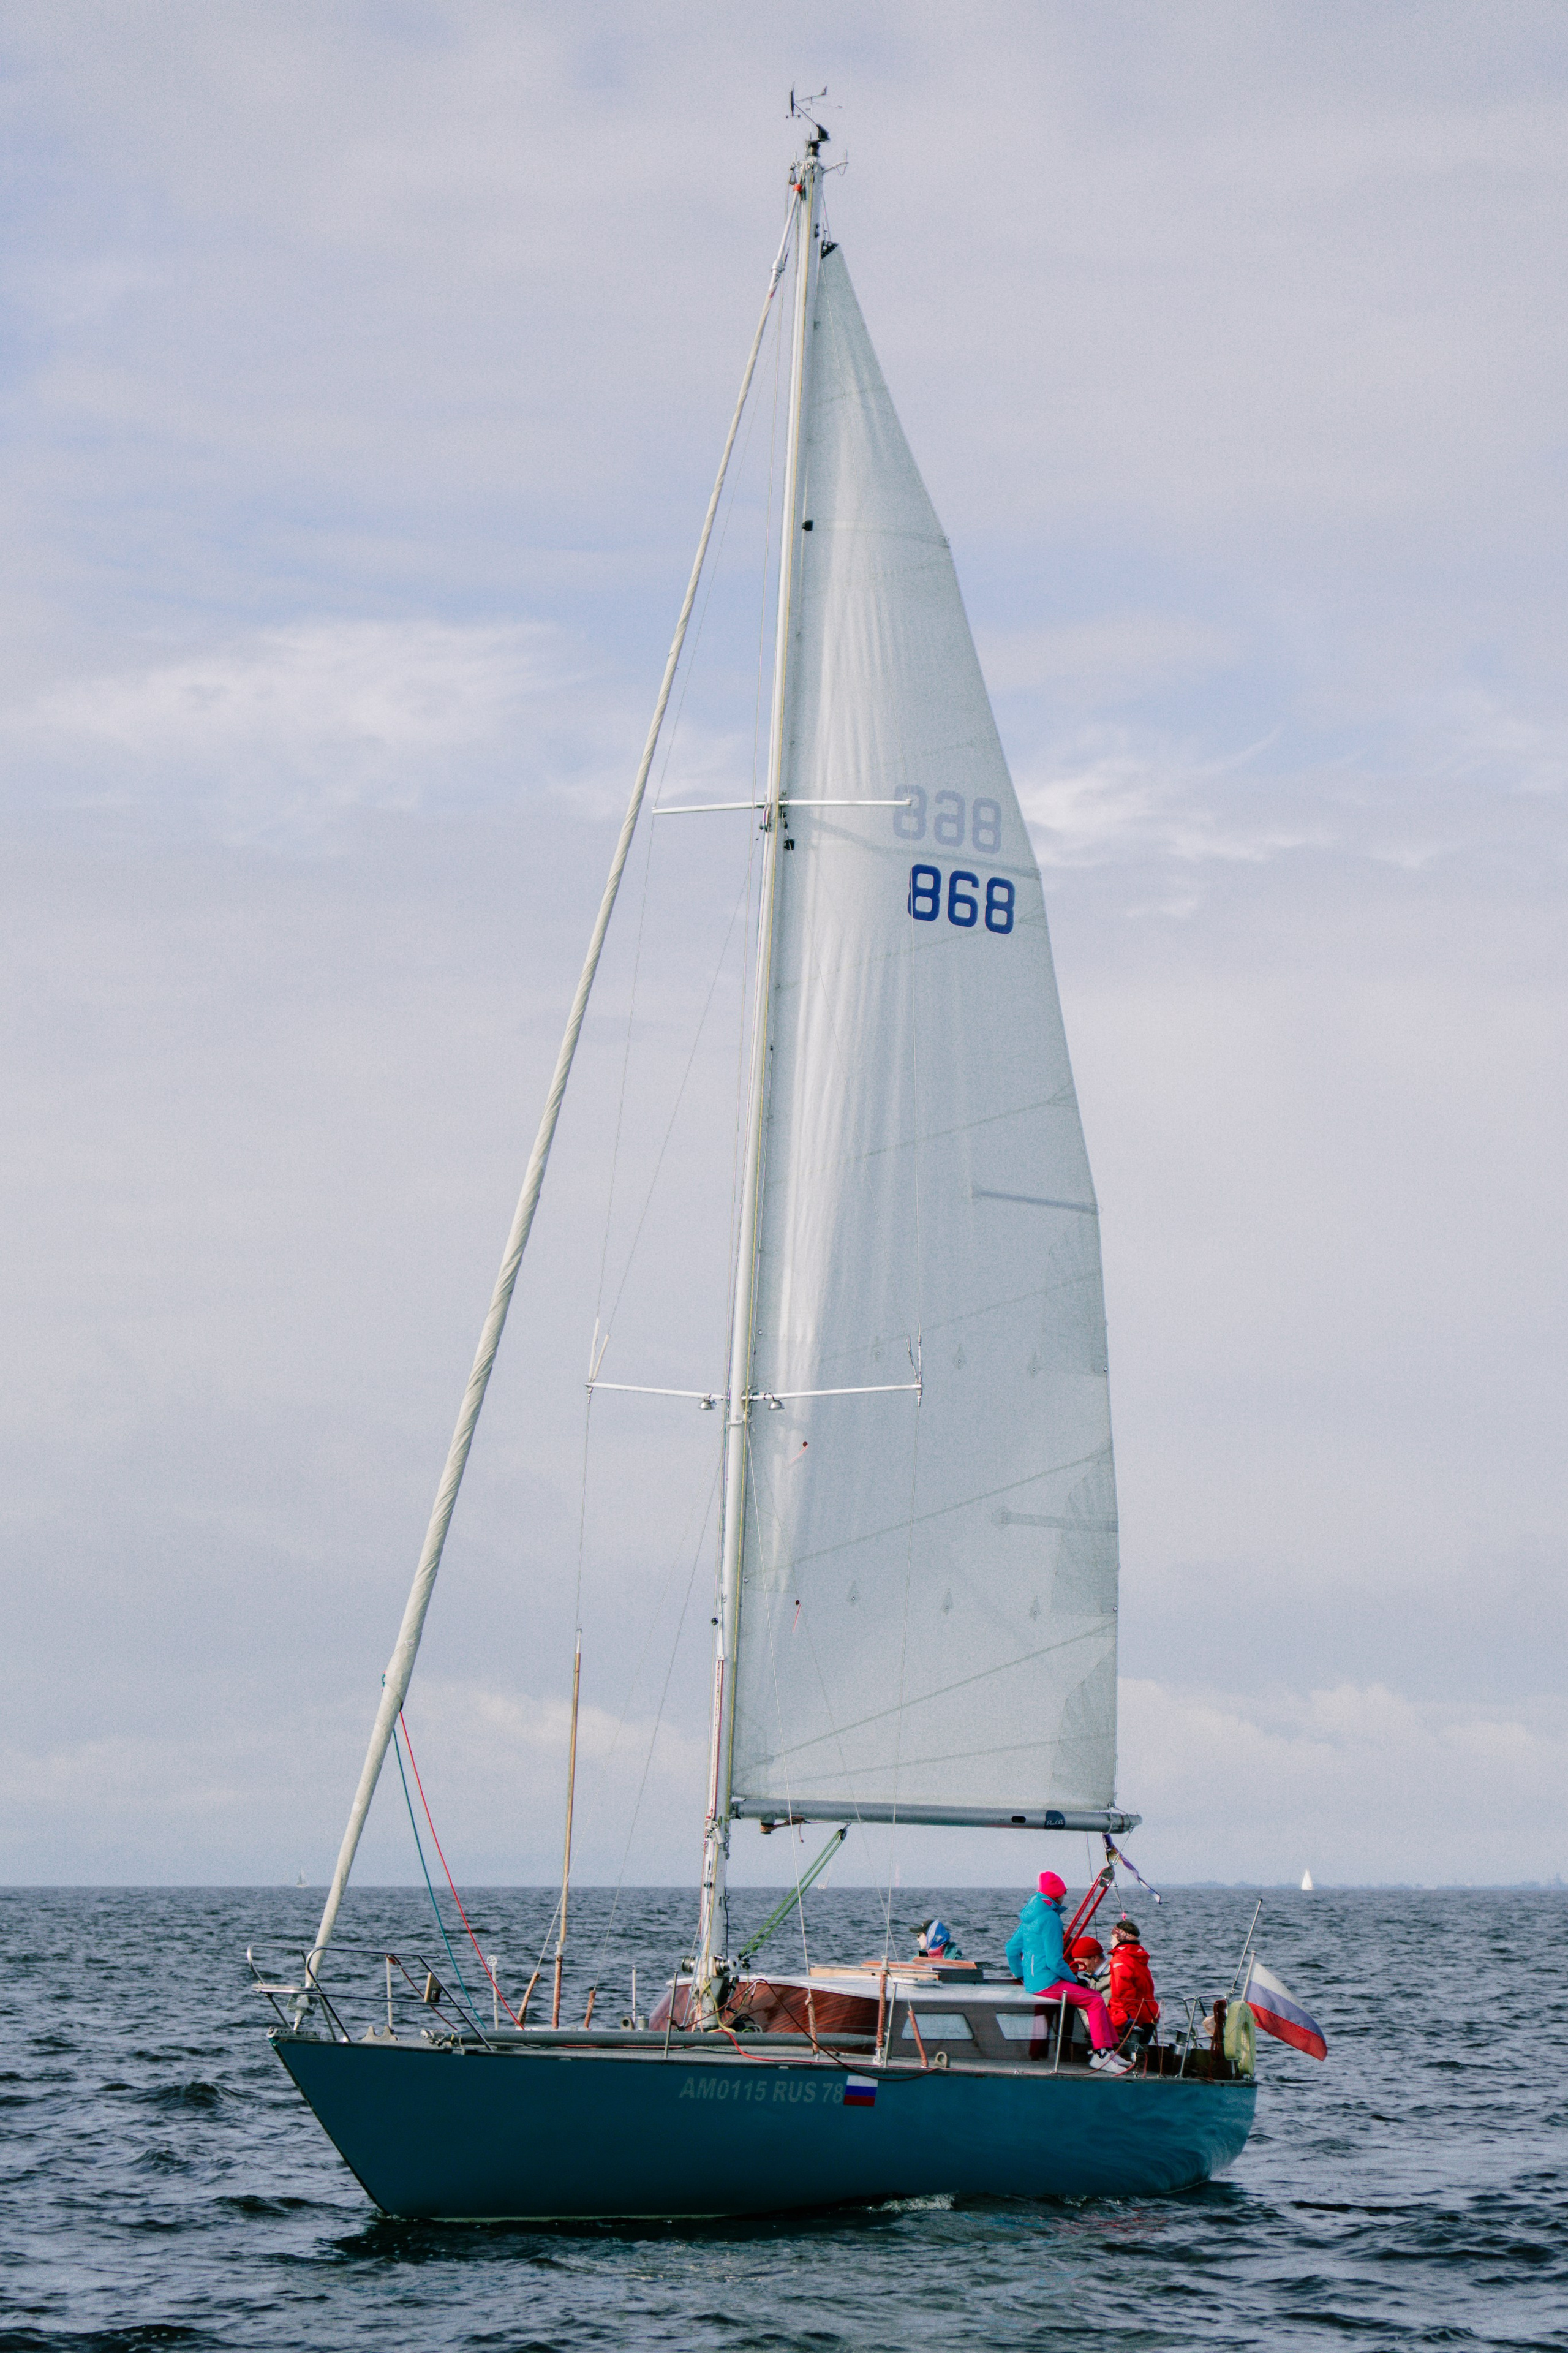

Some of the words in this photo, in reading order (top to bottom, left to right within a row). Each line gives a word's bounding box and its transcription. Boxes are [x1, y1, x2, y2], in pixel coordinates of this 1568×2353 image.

[908, 864, 1015, 934] 868
[772, 2081, 816, 2102] RUS
[823, 2083, 844, 2104] 78
